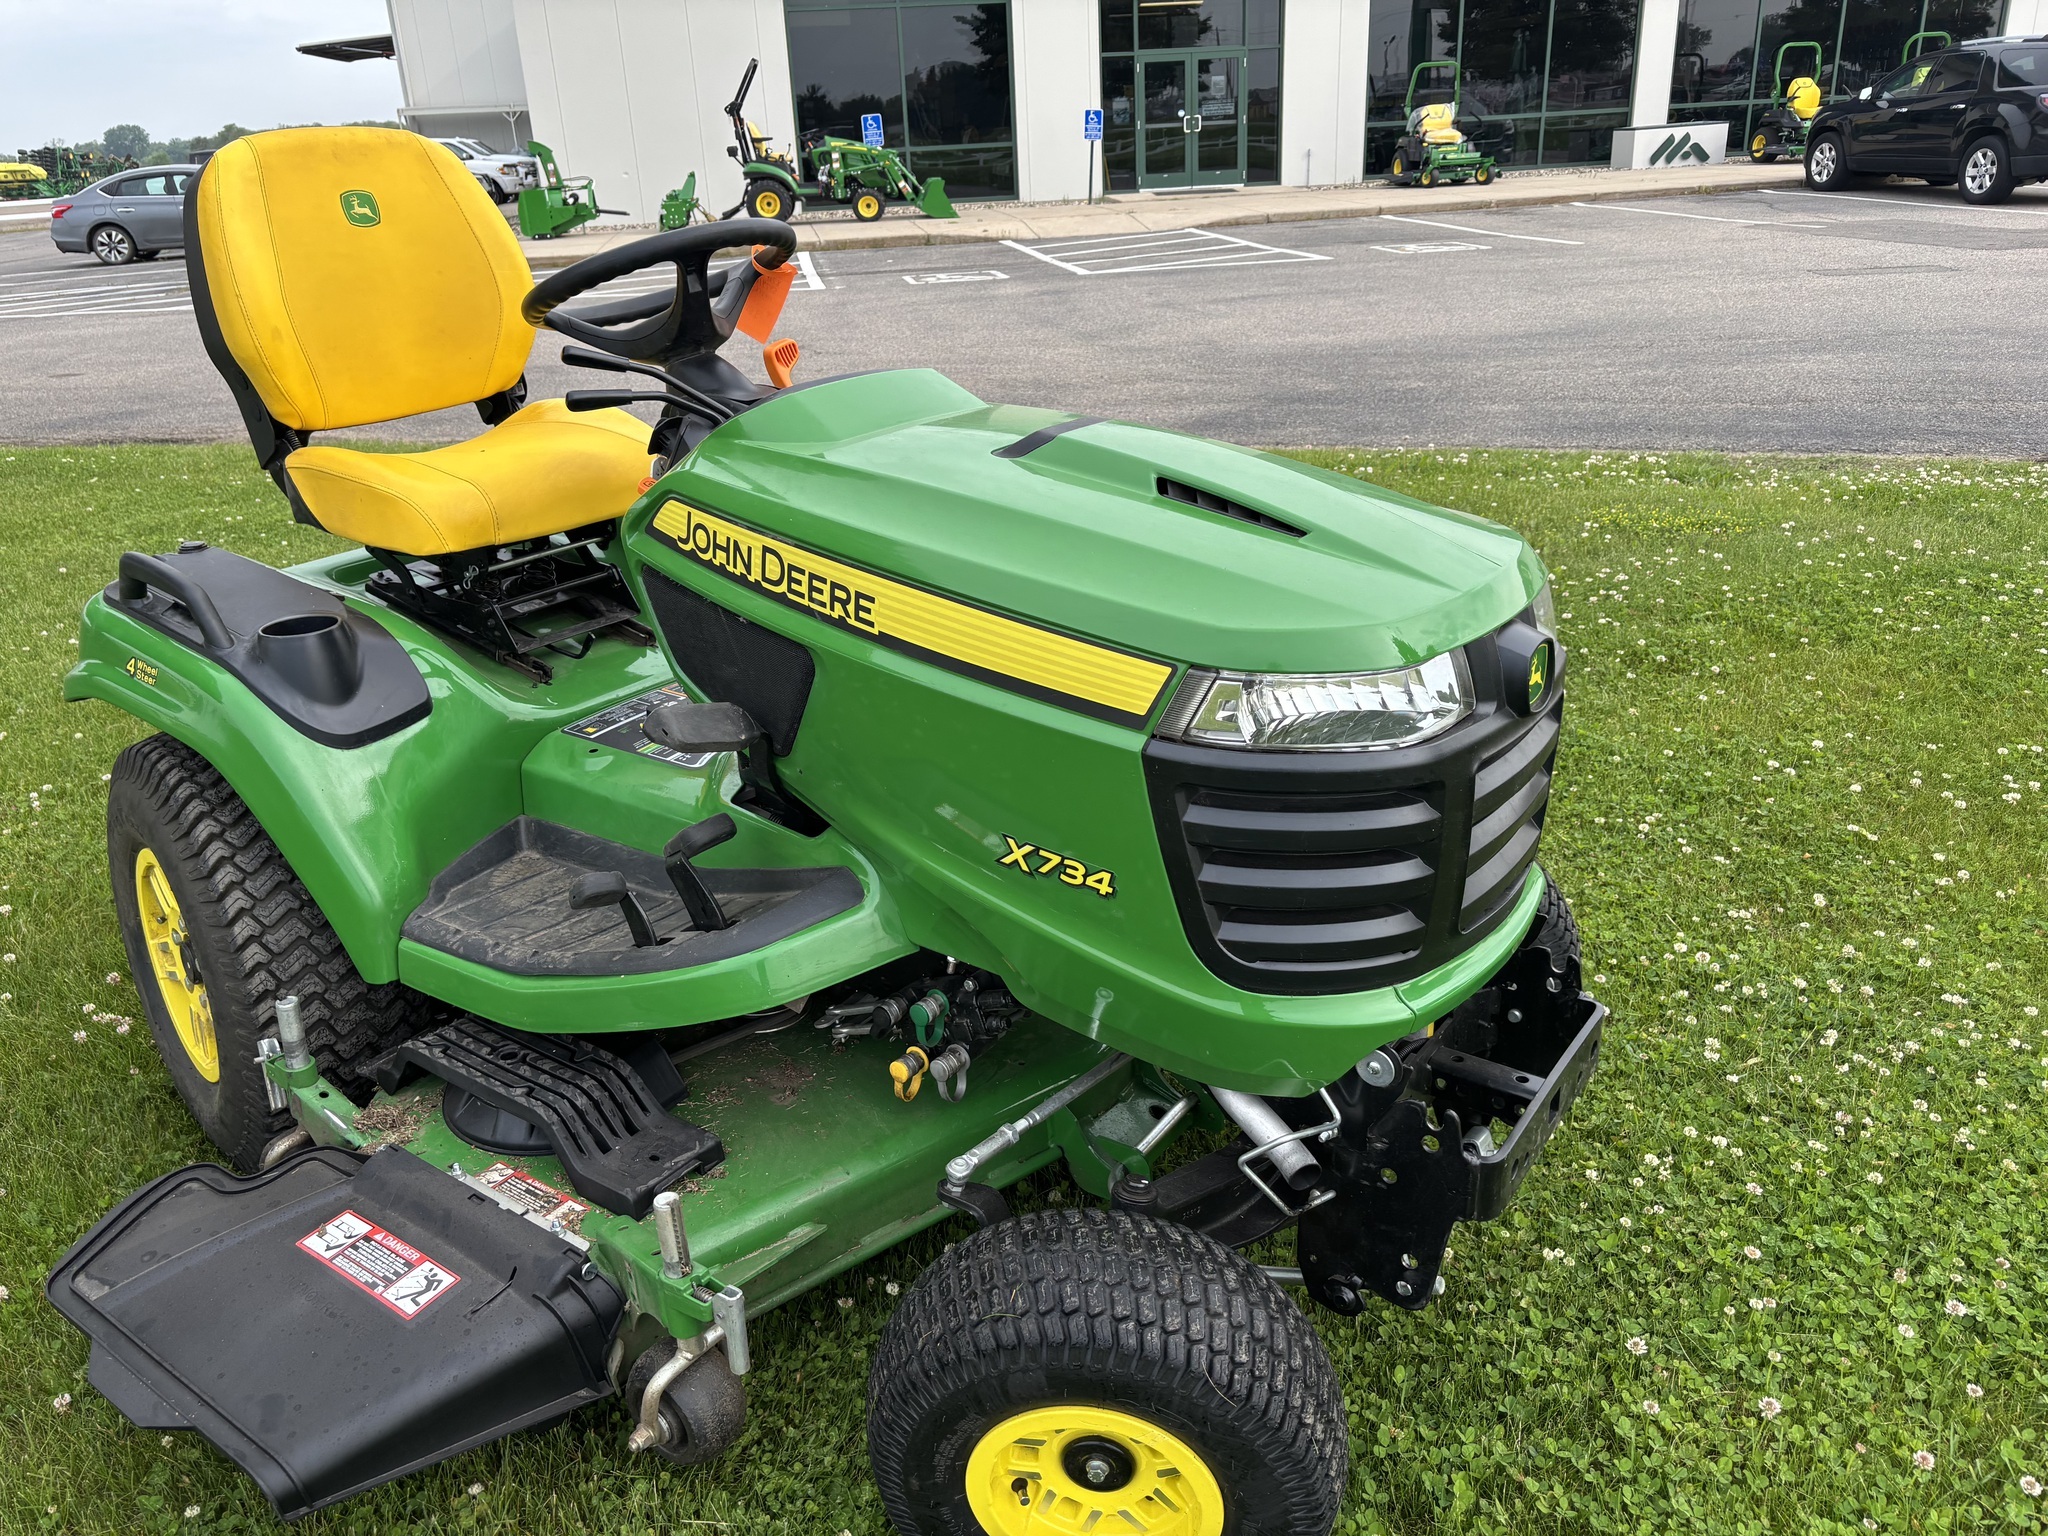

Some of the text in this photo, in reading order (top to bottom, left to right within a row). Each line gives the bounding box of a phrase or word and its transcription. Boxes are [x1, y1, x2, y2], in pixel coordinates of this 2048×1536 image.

[676, 510, 876, 629] JOHN DEERE
[126, 657, 136, 676] 4
[136, 669, 156, 686] Steer
[137, 659, 159, 677] Wheel
[998, 834, 1115, 897] X734
[382, 1236, 420, 1261] DANGER
